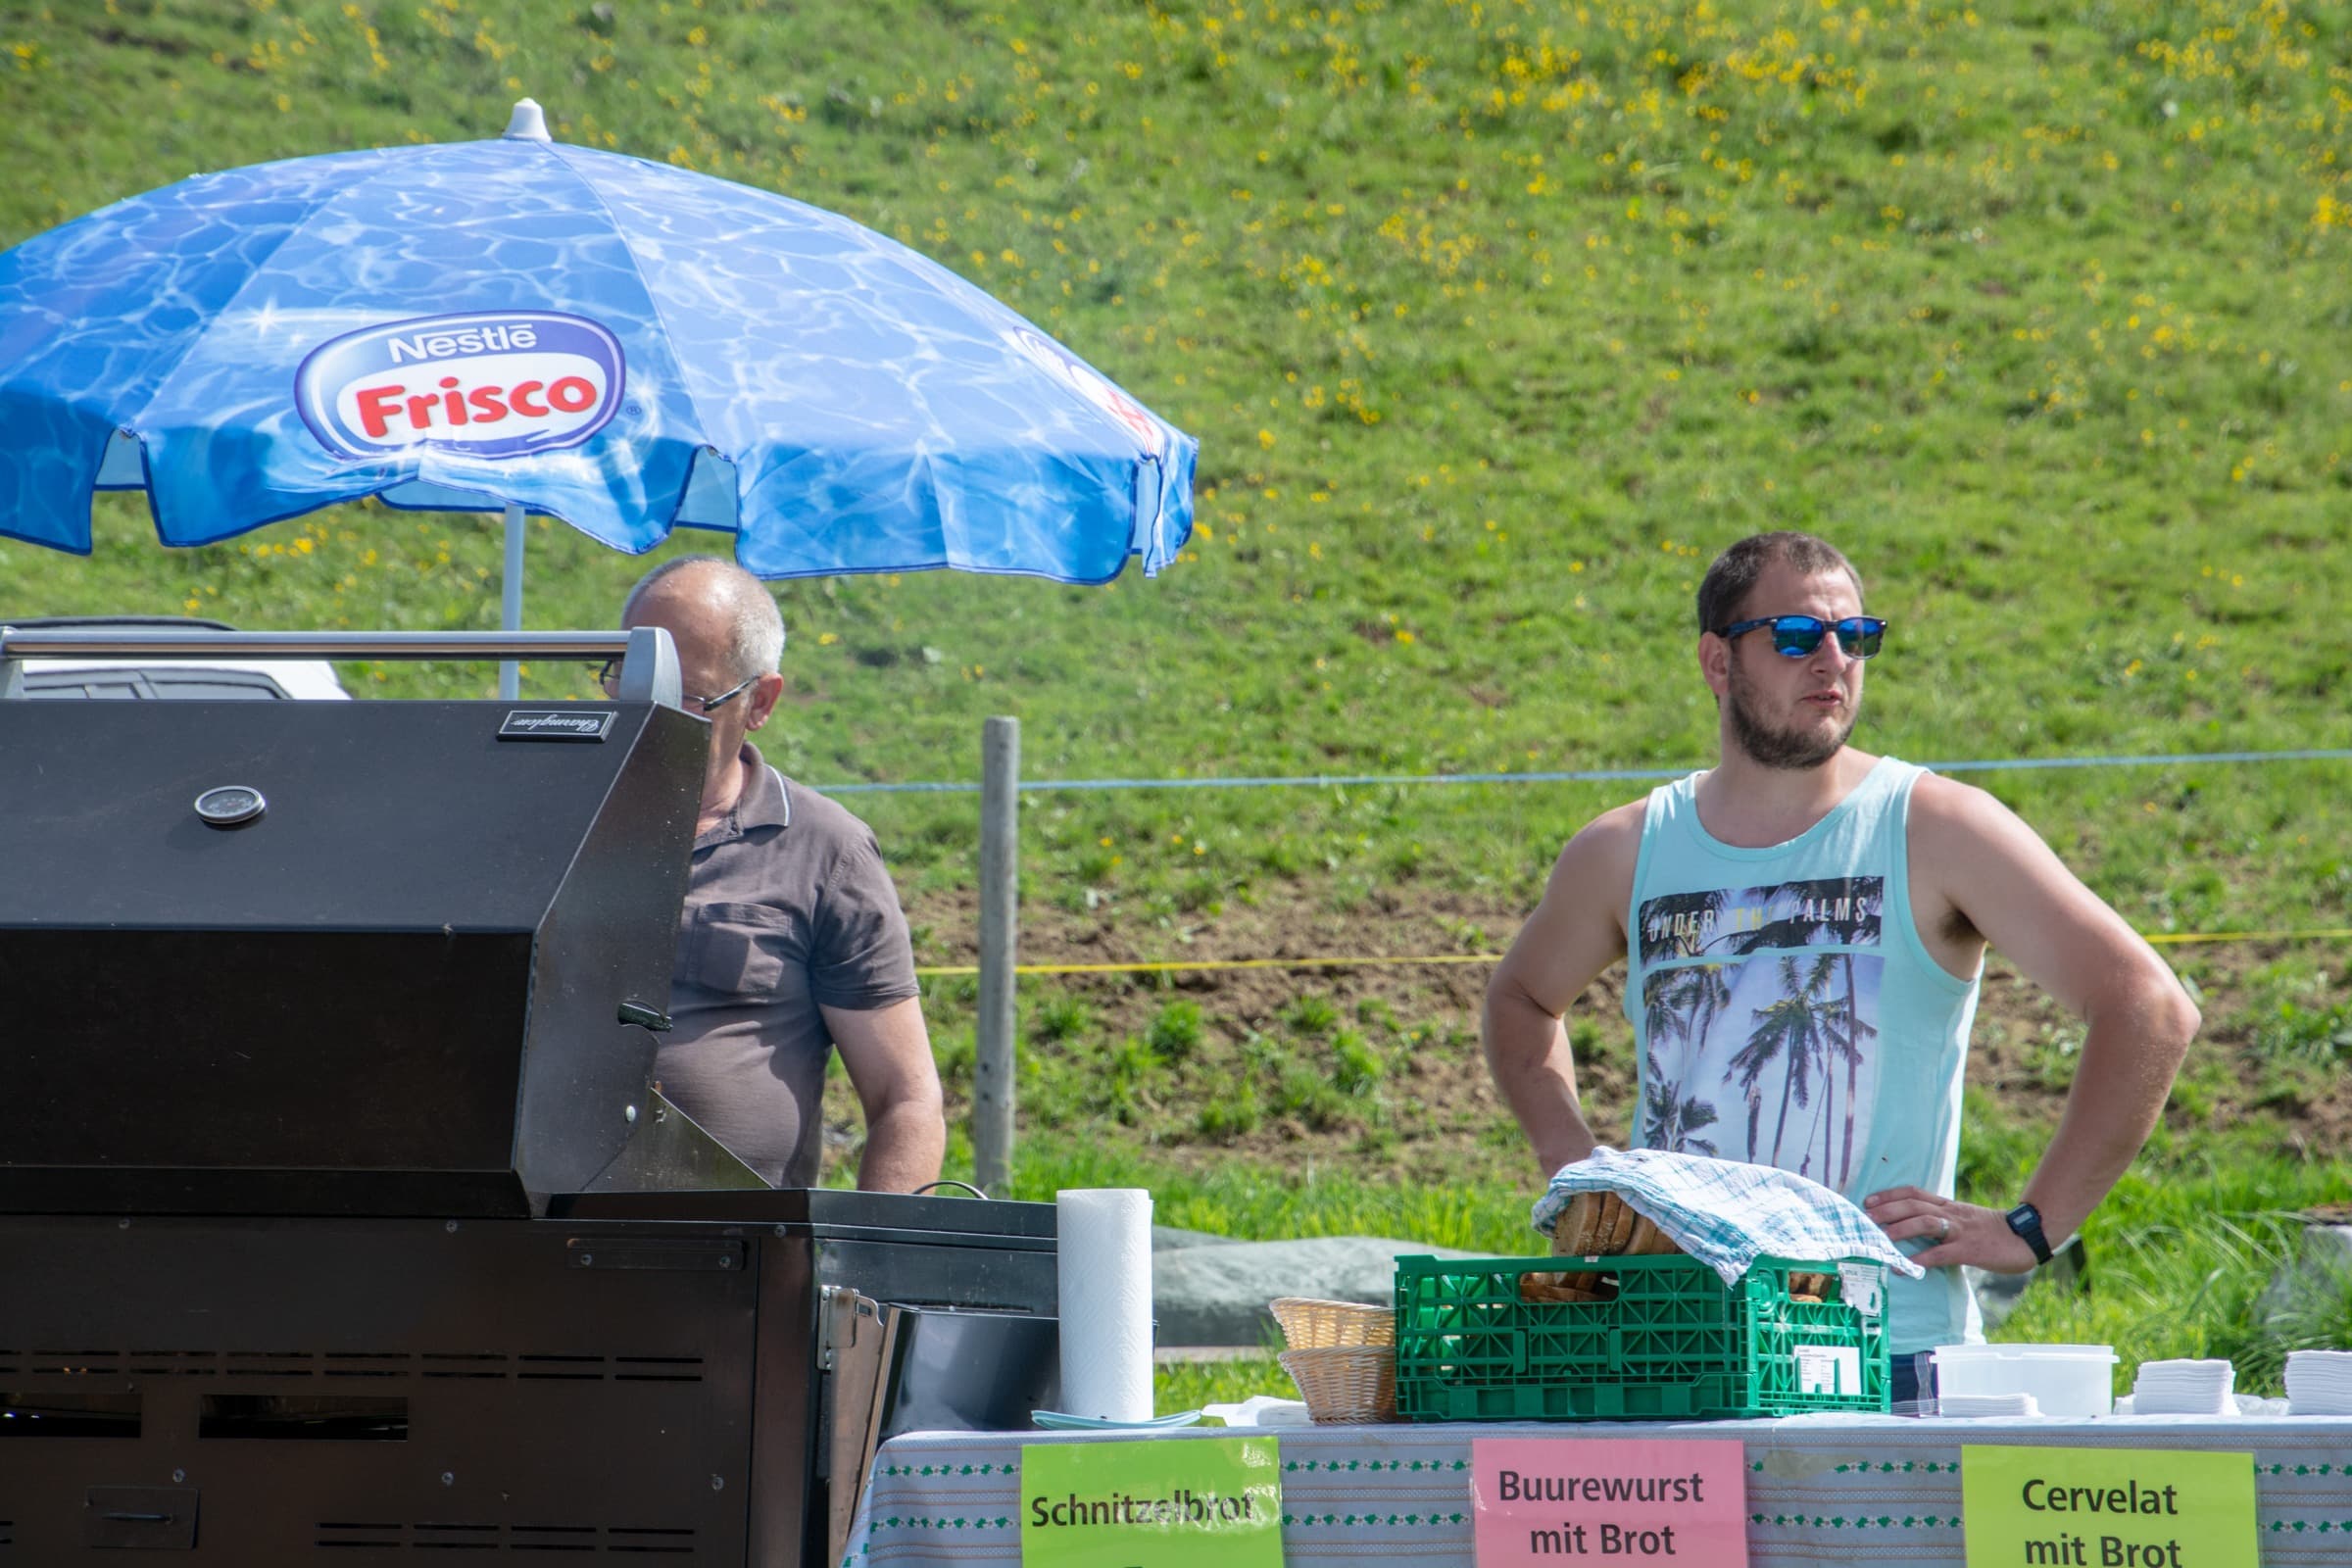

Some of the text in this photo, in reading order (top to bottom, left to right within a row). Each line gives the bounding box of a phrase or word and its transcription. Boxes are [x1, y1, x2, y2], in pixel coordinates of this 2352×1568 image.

[356, 375, 597, 438] Frisco
[1789, 897, 1868, 924] PALMS
[1499, 1470, 1704, 1502] Buurewurst
[2022, 1479, 2178, 1515] Cervelat
[1032, 1490, 1255, 1527] Schnitzelbrot
[1530, 1522, 1676, 1555] mit Brot
[2025, 1533, 2182, 1568] mit Brot
